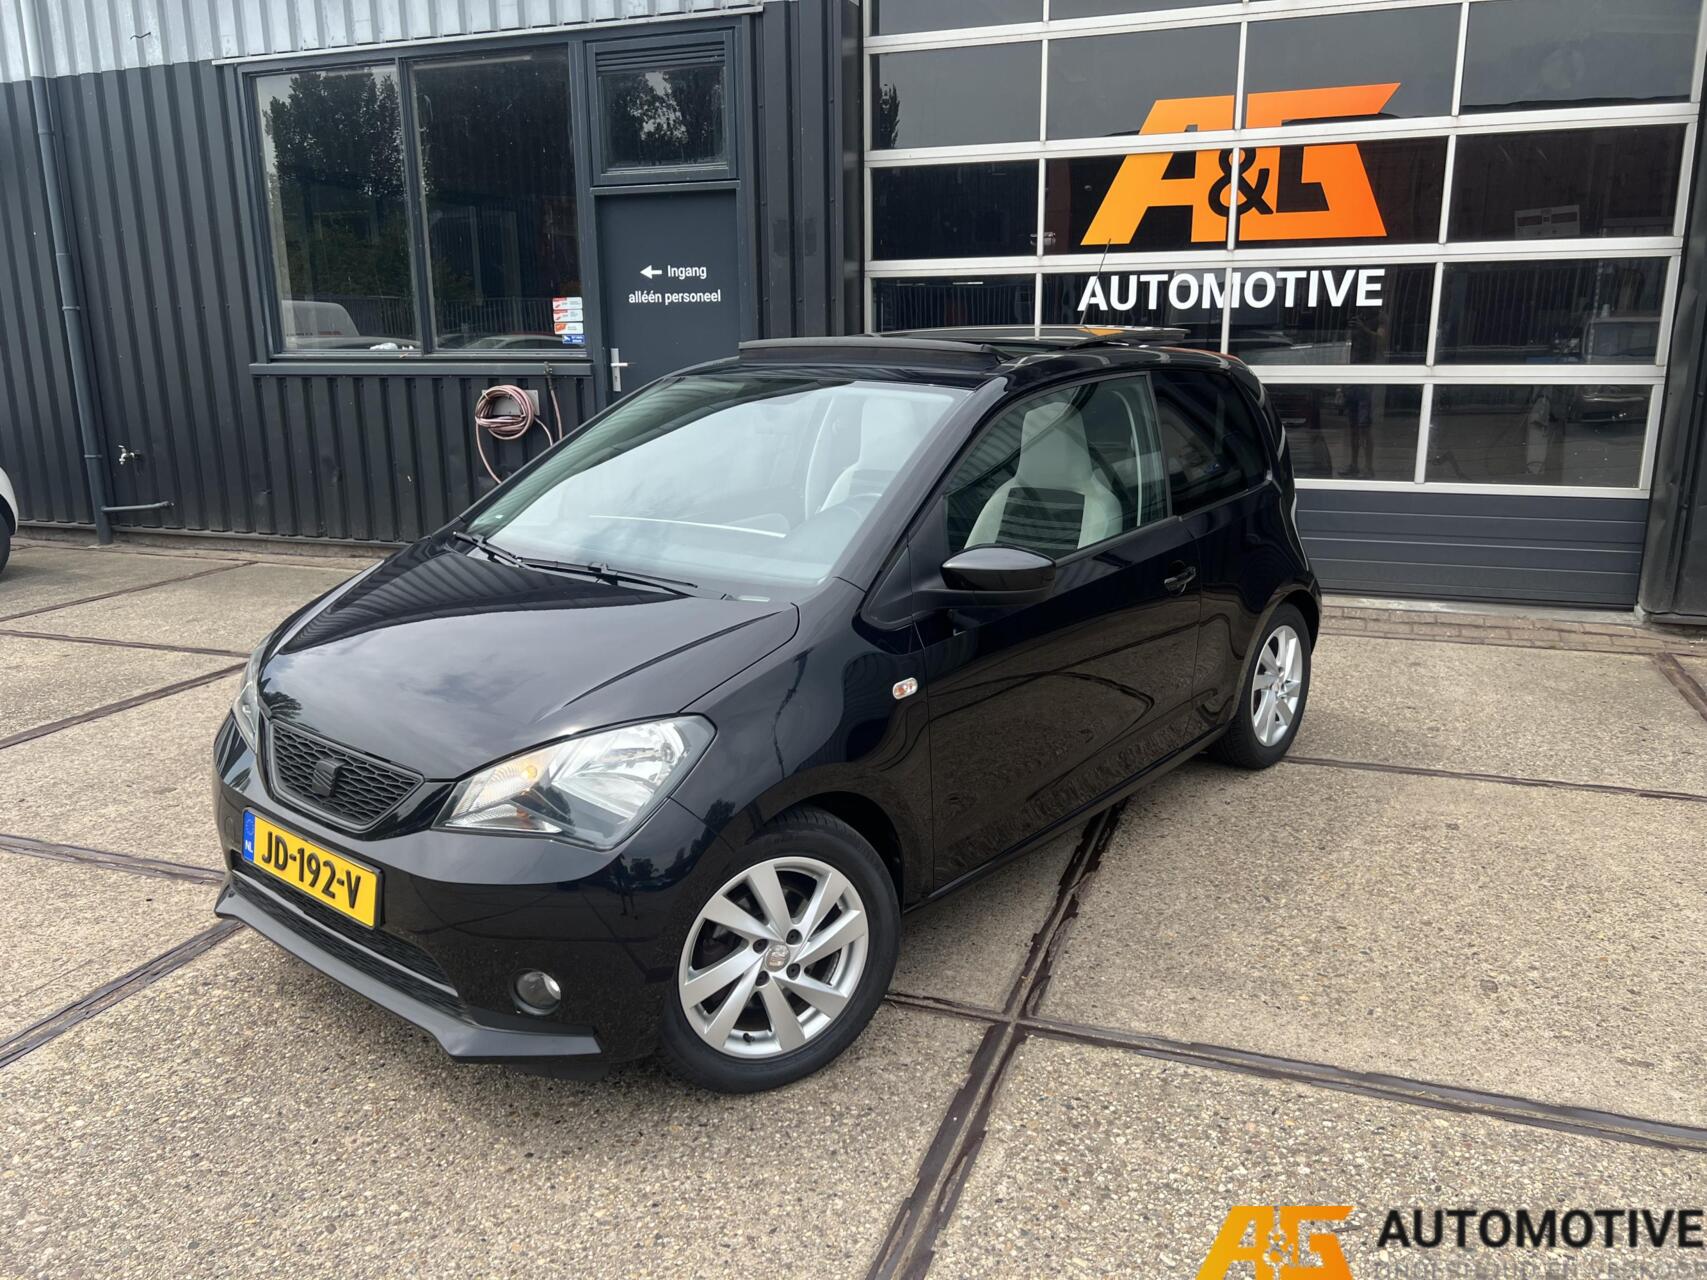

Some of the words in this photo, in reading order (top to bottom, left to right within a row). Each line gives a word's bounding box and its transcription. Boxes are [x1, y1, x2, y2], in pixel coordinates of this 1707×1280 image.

[1080, 83, 1401, 246] A&G
[667, 265, 707, 280] Ingang
[628, 289, 663, 303] alléén
[664, 288, 721, 306] personeel
[1077, 268, 1386, 312] AUTOMOTIVE
[244, 839, 254, 853] NL
[261, 831, 362, 910] JD-192-V
